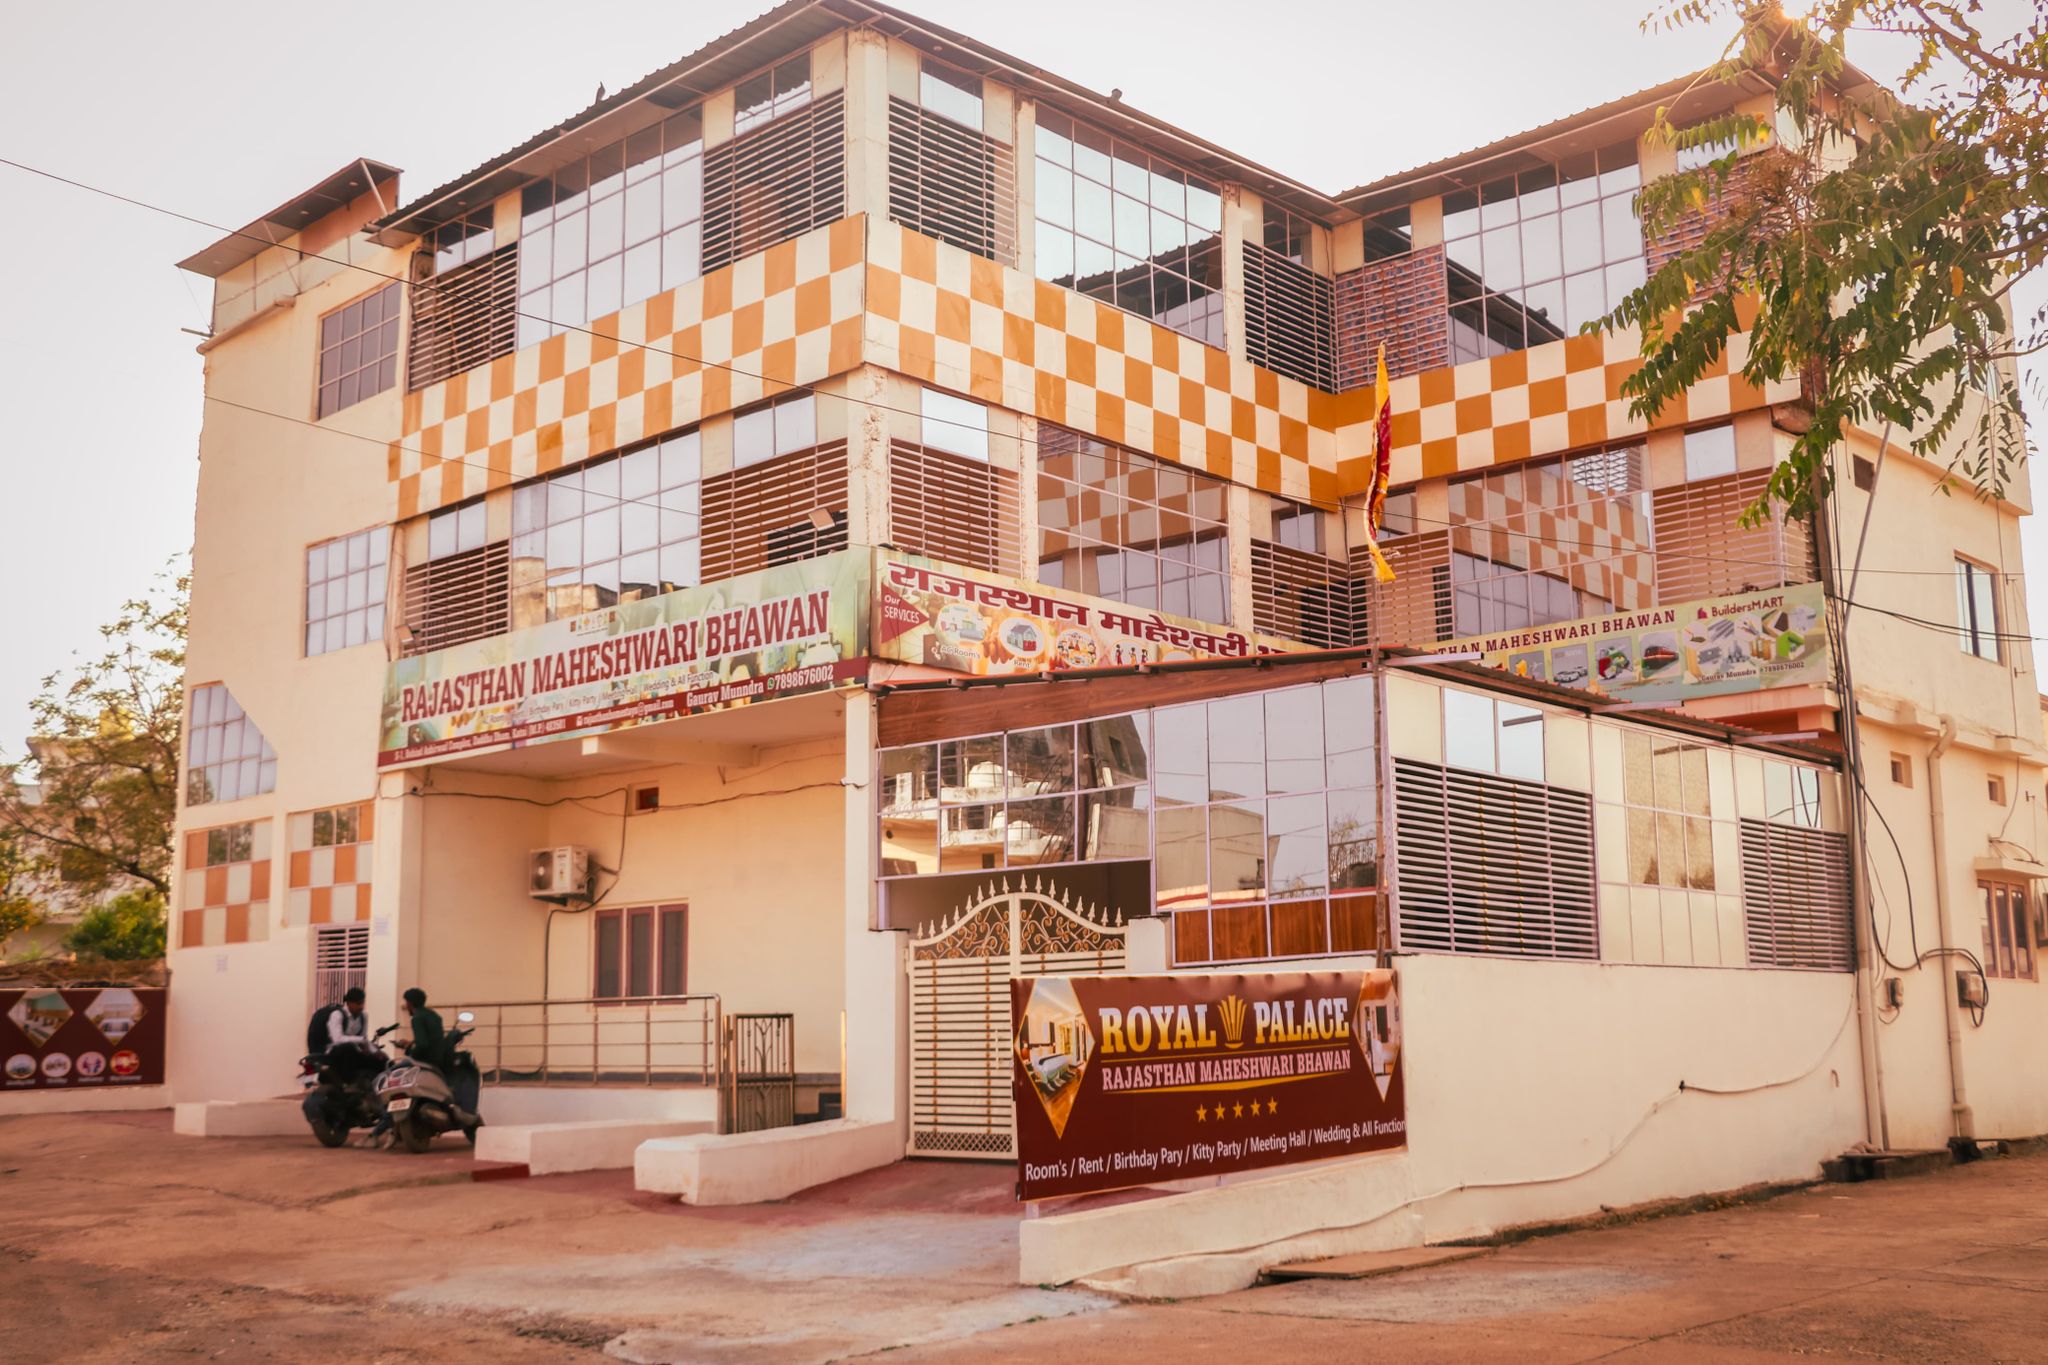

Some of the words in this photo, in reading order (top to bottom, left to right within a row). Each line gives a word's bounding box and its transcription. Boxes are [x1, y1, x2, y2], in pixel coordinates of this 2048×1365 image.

[887, 561, 1090, 626] राजस्थान
[1711, 596, 1784, 618] BuildersMART
[884, 606, 920, 625] SERVICES
[1486, 623, 1597, 652] MAHESHWARI
[1602, 610, 1676, 633] BHAWAN
[402, 661, 526, 722] RAJASTHAN
[532, 620, 698, 694] MAHESHWARI
[706, 590, 829, 658] BHAWAN
[678, 673, 686, 685] All
[687, 670, 714, 684] Function
[686, 690, 719, 708] Gaurav
[721, 680, 764, 701] Munndra
[775, 664, 834, 691] 7898676002
[1099, 1003, 1217, 1053] ROYAL
[1253, 997, 1349, 1044] PALACE
[1102, 1061, 1196, 1090] RAJASTHAN
[1200, 1054, 1294, 1083] MAHESHWARI
[1298, 1049, 1351, 1074] BHAWAN
[1026, 1159, 1067, 1181] Room's
[1078, 1156, 1104, 1175] Rent
[1114, 1149, 1158, 1171] Birthday
[1161, 1147, 1184, 1167] Pary
[1192, 1143, 1215, 1162] Kitty
[1217, 1140, 1242, 1159] Party
[1250, 1134, 1288, 1153] Meeting
[1289, 1129, 1307, 1147] Hall
[1314, 1124, 1351, 1143] Wedding
[1353, 1124, 1361, 1138] &
[1362, 1120, 1373, 1136] All
[1374, 1118, 1407, 1135] Function
